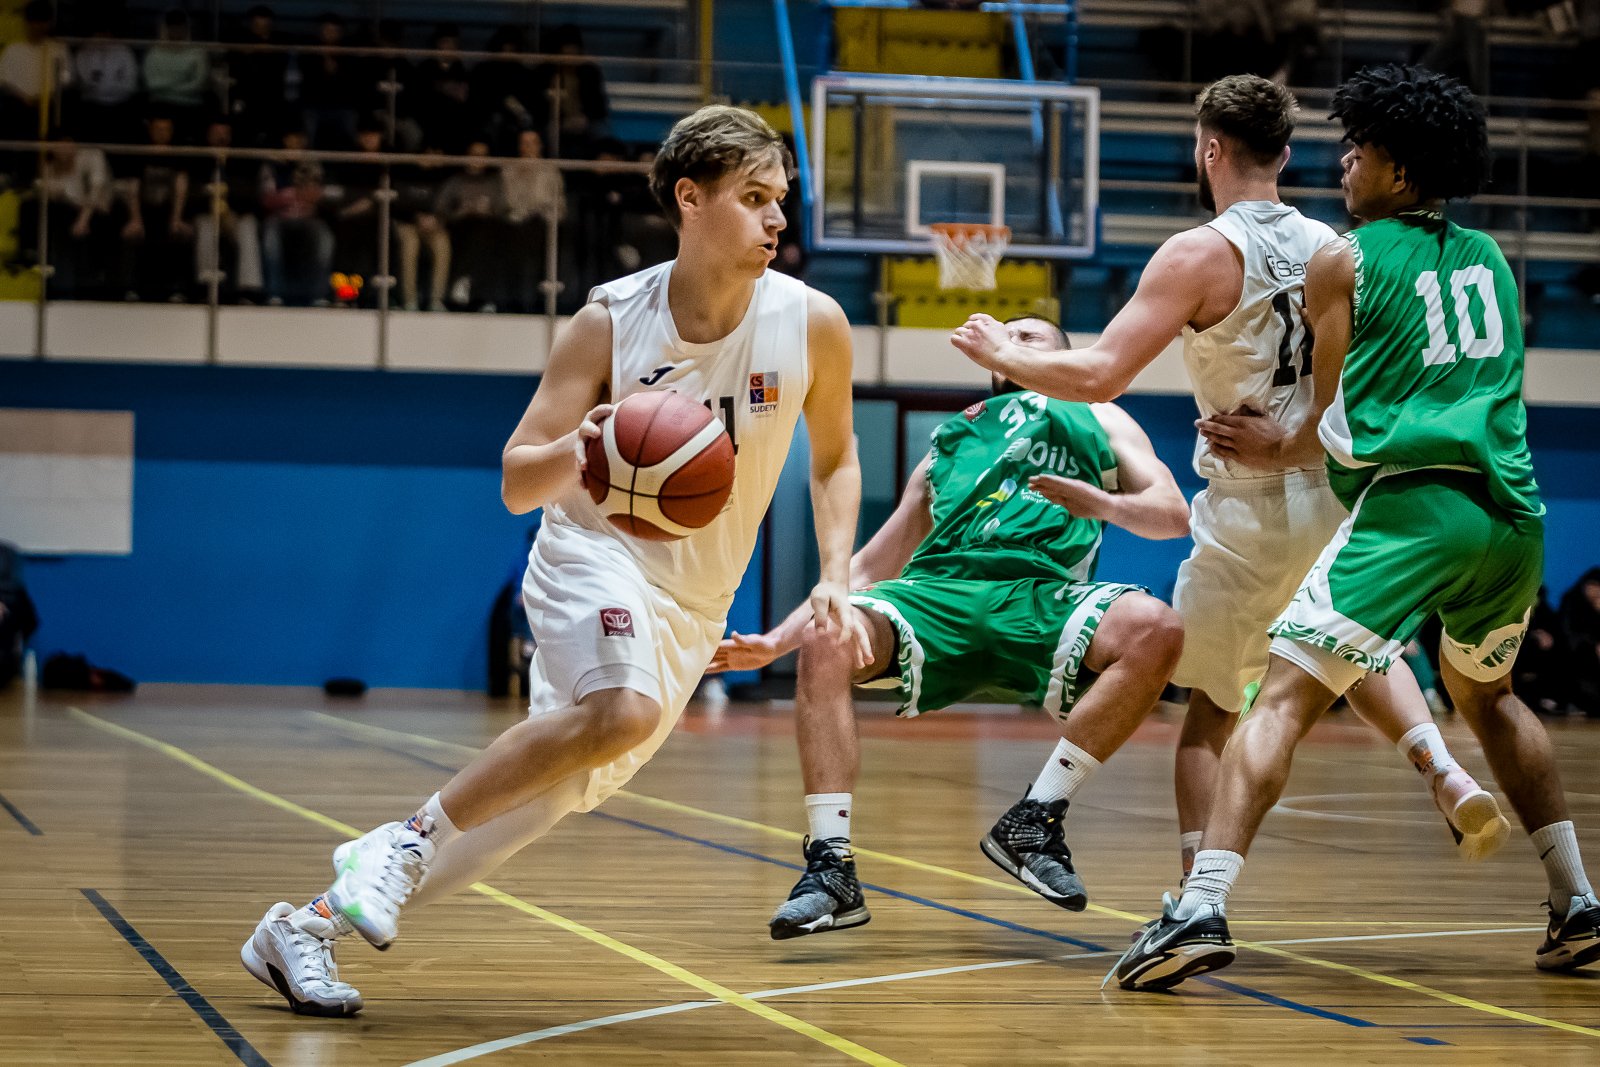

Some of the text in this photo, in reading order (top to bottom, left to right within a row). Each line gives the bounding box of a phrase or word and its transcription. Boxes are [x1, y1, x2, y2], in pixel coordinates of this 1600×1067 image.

[1415, 264, 1505, 367] 10
[703, 396, 739, 456] 1
[750, 404, 778, 413] SUDETY
[1000, 391, 1049, 438] 33
[1027, 441, 1080, 476] Oils
